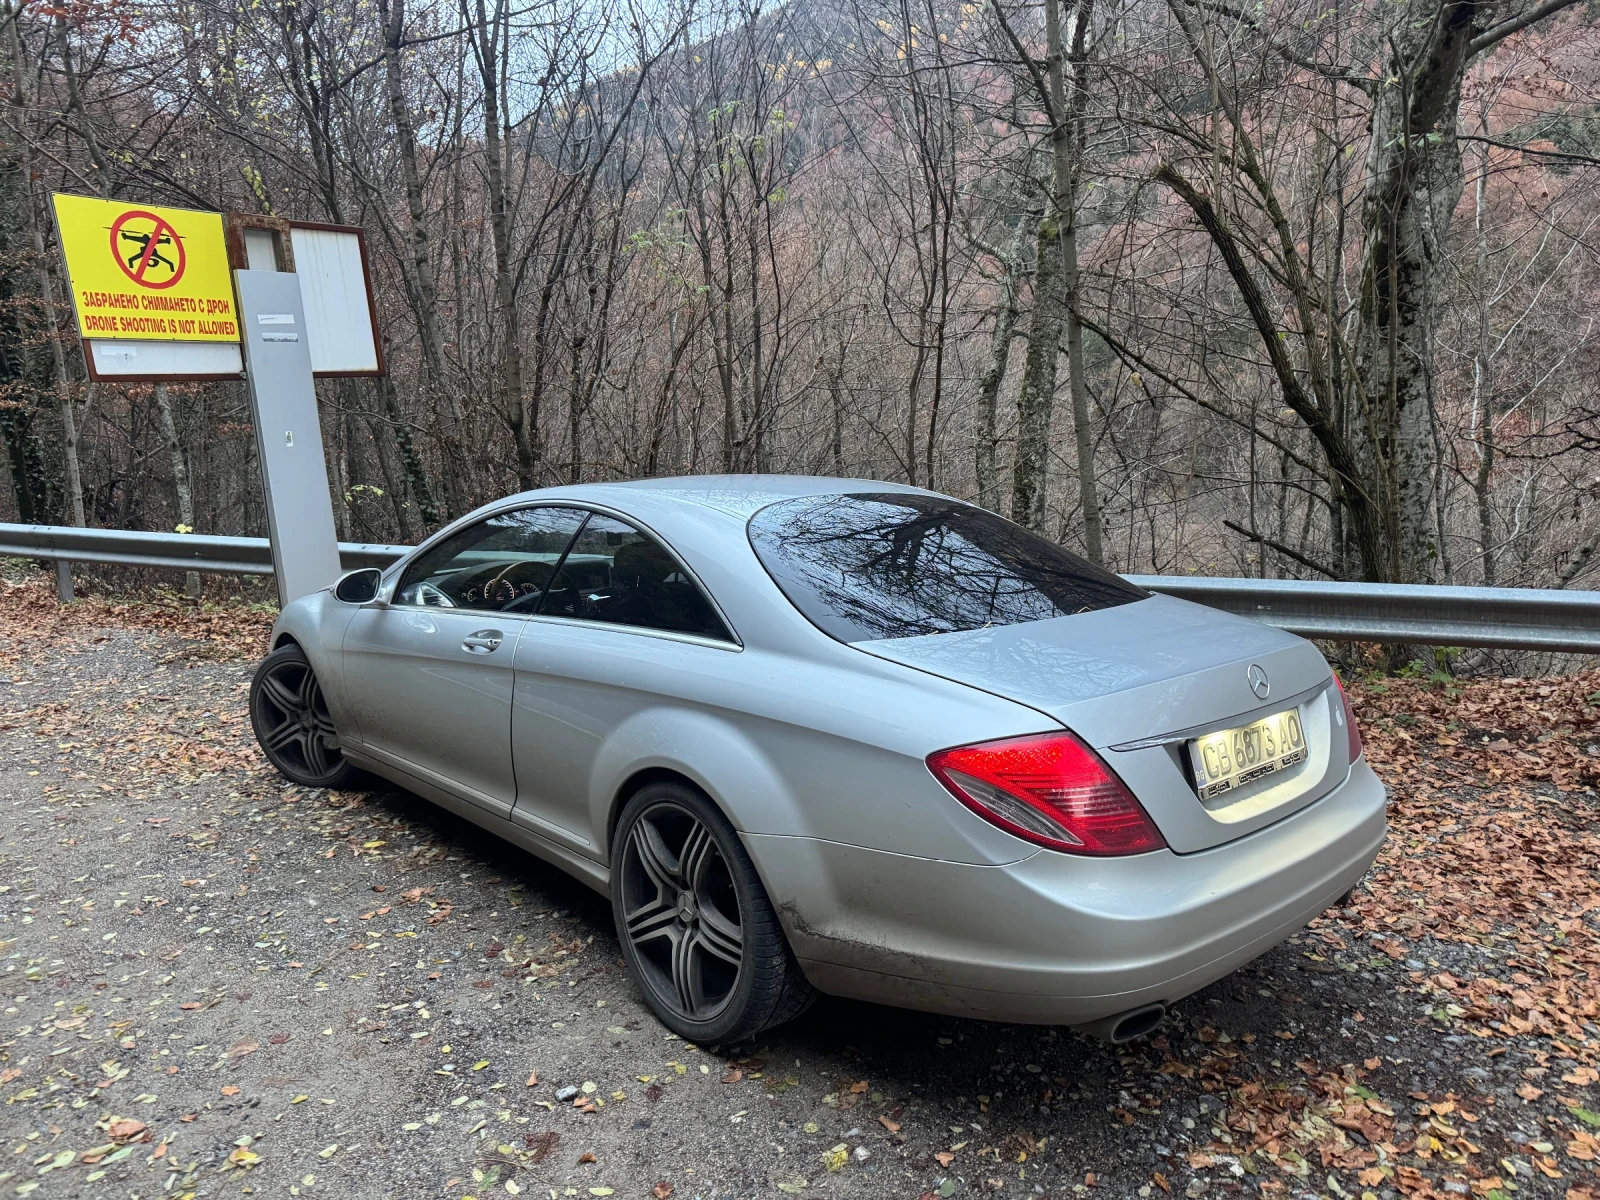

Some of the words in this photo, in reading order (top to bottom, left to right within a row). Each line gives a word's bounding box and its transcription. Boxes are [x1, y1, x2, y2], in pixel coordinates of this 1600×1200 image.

[82, 291, 139, 310] ЗАБРАНЕНО
[141, 295, 197, 312] СНИМАНЕТО
[198, 298, 205, 313] С
[207, 299, 230, 316] ДРОН
[84, 315, 118, 331] DRONE
[119, 317, 167, 333] SHOOTING
[168, 319, 177, 333] IS
[178, 319, 195, 334] NOT
[198, 320, 236, 336] ALLOWED
[1232, 723, 1276, 768] 6873
[1195, 770, 1205, 782] BG
